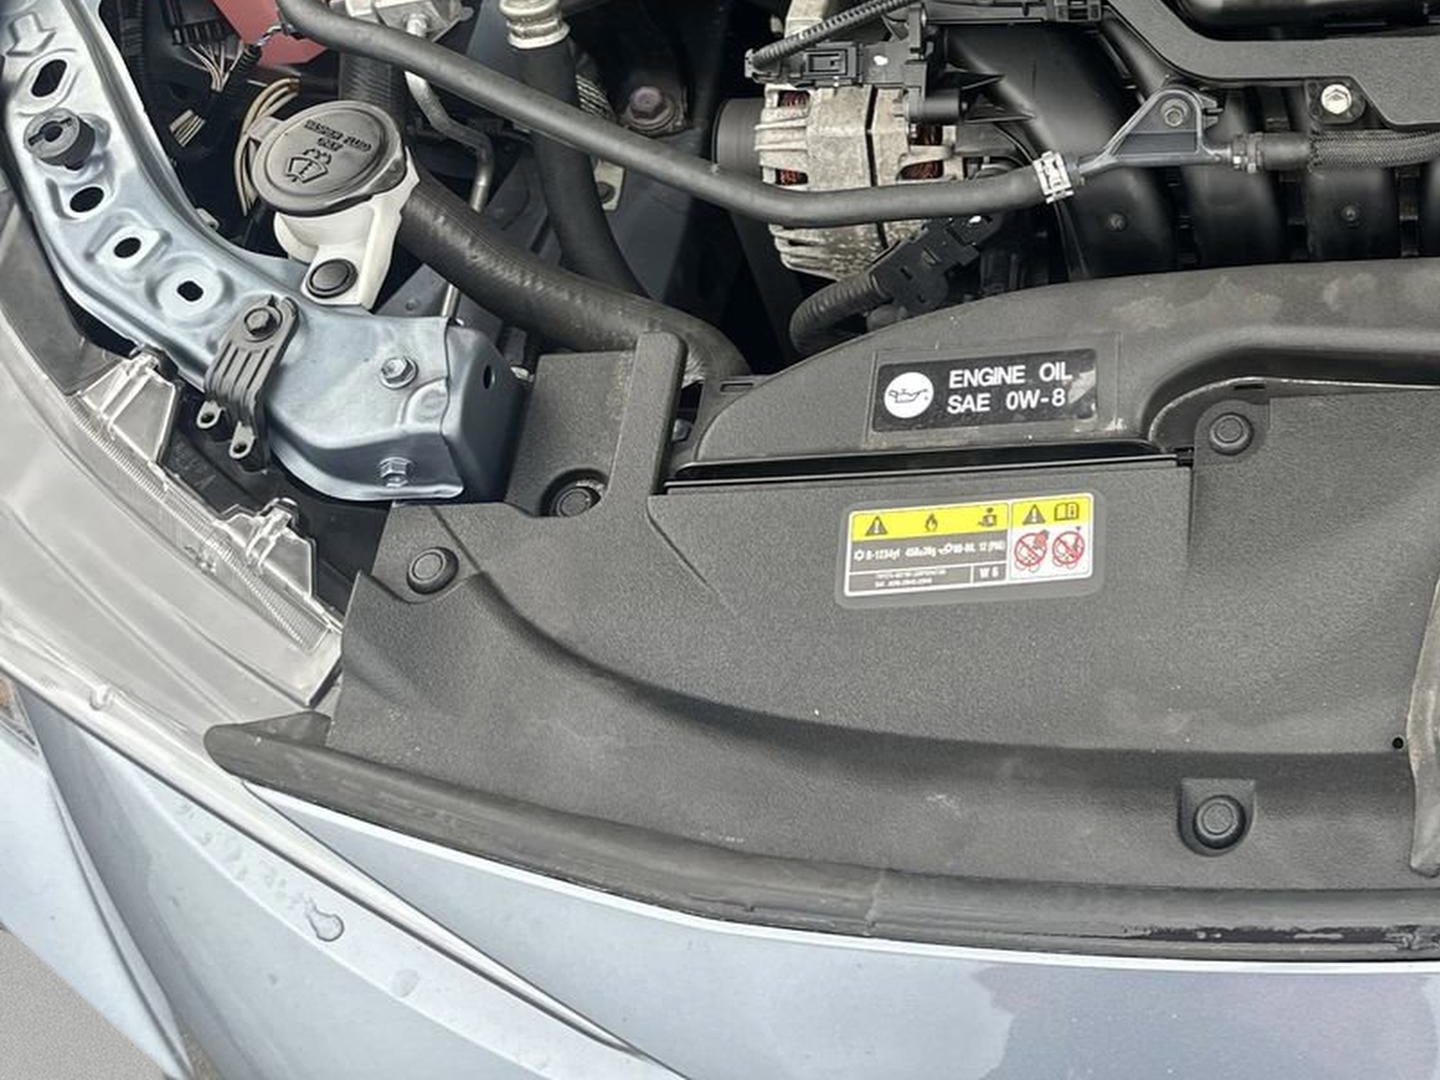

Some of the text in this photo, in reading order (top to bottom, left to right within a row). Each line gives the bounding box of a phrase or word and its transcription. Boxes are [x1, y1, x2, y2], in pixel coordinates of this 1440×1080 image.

[949, 361, 1073, 389] ENGINE OIL
[946, 388, 1066, 414] SAE 0W-8
